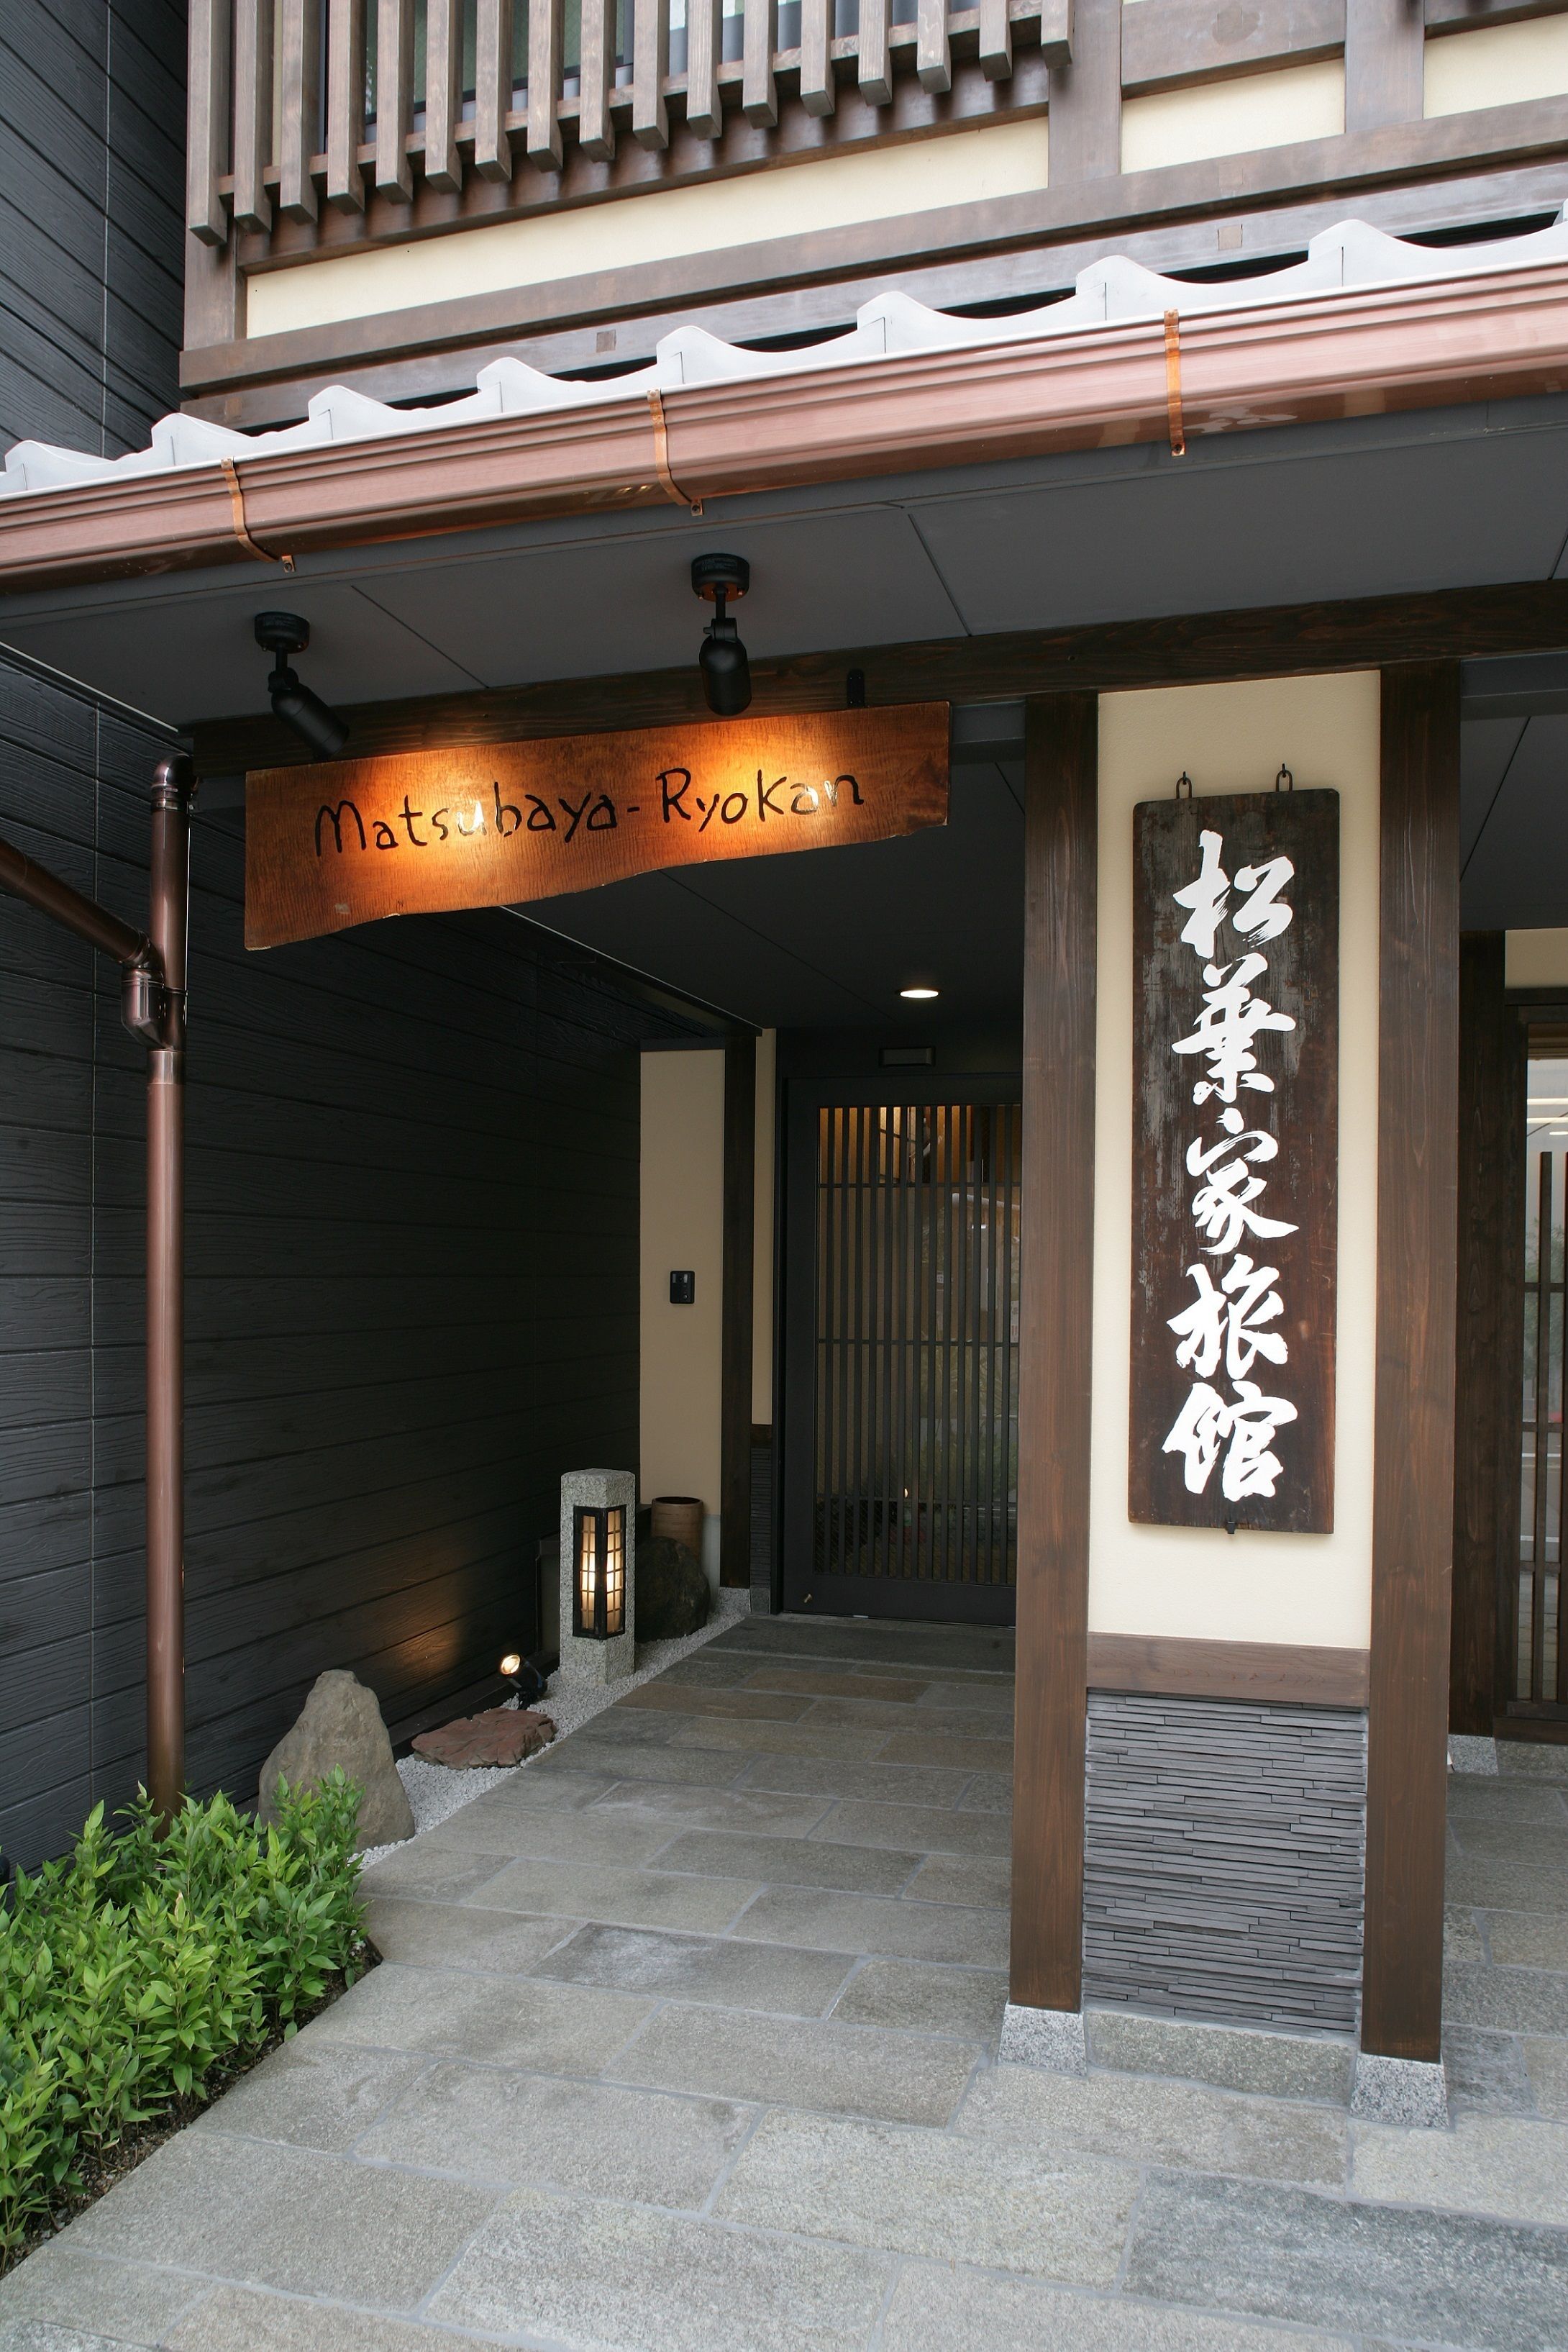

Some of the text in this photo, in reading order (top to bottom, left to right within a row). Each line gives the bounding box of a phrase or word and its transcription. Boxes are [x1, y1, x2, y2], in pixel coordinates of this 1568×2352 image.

[1162, 830, 1299, 1502] 松葉家旅館
